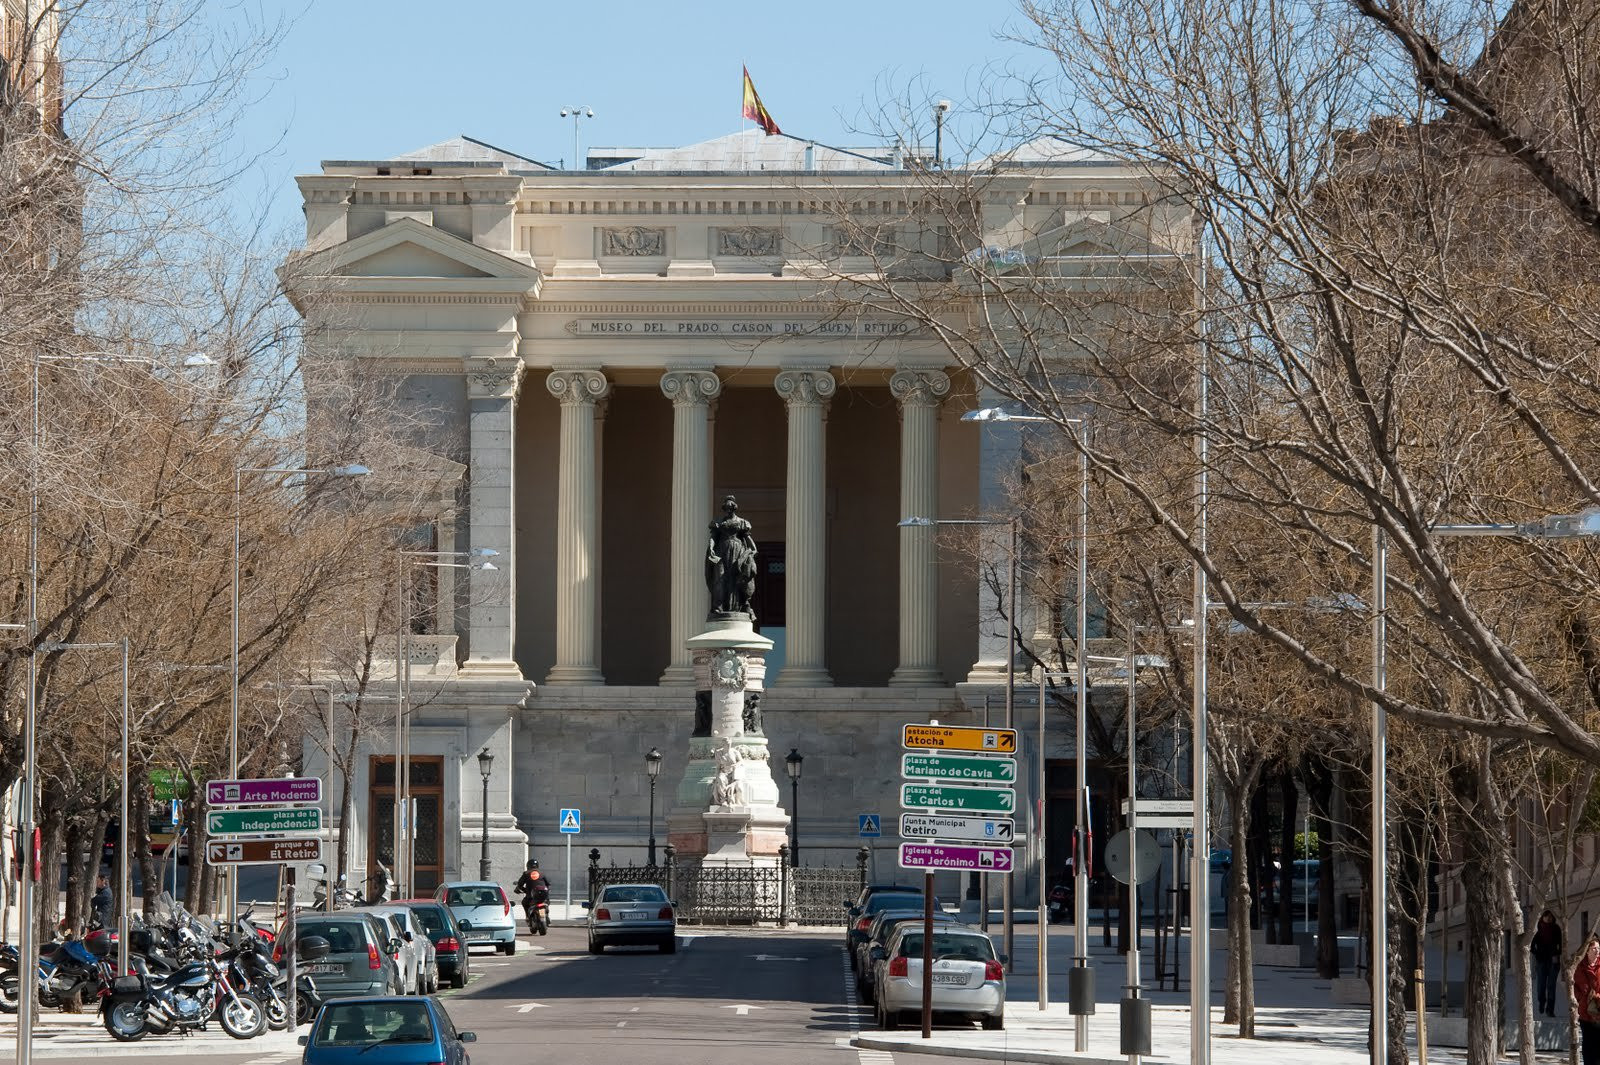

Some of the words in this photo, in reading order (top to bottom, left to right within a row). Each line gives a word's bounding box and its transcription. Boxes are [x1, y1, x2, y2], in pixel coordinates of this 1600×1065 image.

[591, 322, 633, 333] MUSEO
[644, 322, 667, 333] DEL
[678, 323, 719, 333] PRADO
[732, 323, 773, 333] CASON
[784, 323, 804, 333] DEL
[820, 323, 853, 333] BUEN
[864, 323, 908, 333] RETIRO
[907, 728, 941, 736] estación
[943, 729, 954, 737] de
[906, 735, 945, 746] Atocha
[905, 757, 928, 765] plaza
[905, 765, 947, 776] Mariano
[948, 767, 961, 777] de
[963, 768, 993, 778] Cavia
[243, 791, 268, 801] Arte
[271, 790, 317, 800] Moderno
[905, 787, 927, 795] plaza
[905, 795, 916, 804] E.
[919, 796, 954, 806] Carlos
[957, 798, 965, 807] V
[273, 811, 295, 820] plaza
[309, 810, 317, 818] la
[241, 819, 318, 831] Independencia
[905, 817, 927, 825] Junta
[928, 819, 966, 828] Municipal
[904, 825, 938, 835] Retiro
[274, 841, 302, 850] parque
[270, 849, 282, 859] El
[285, 849, 318, 859] Retiro
[904, 855, 925, 865] San
[928, 857, 975, 867] Jerónimo
